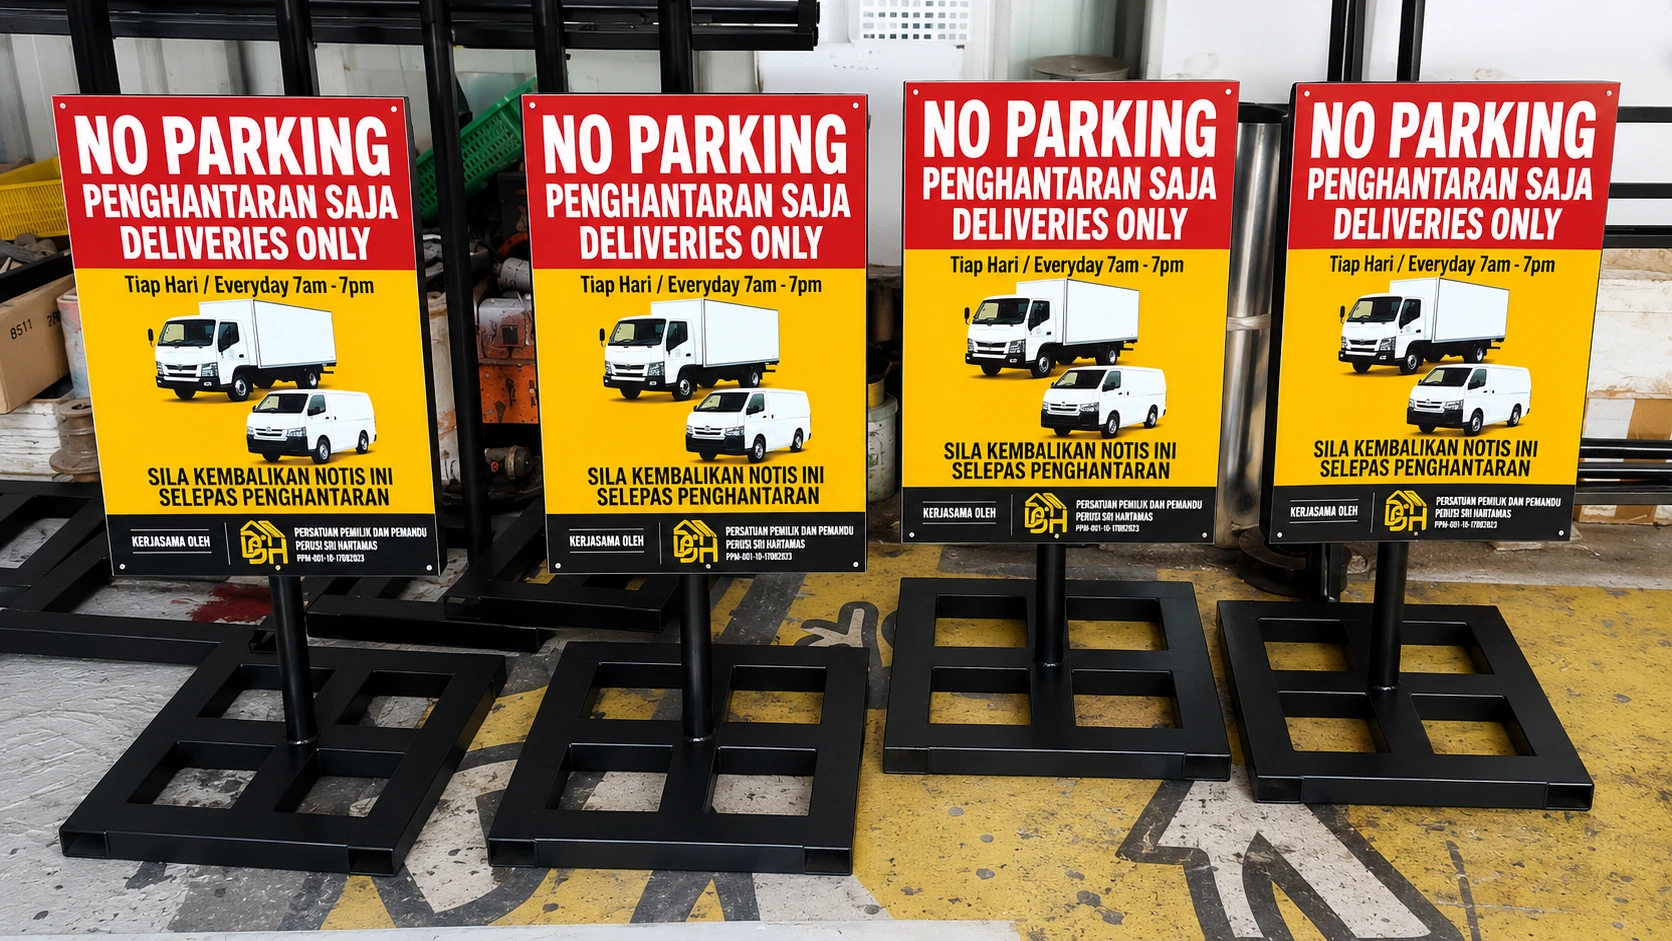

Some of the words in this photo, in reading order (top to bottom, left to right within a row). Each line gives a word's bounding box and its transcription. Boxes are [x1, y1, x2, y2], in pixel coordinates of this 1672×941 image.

[924, 100, 990, 158] NO
[1007, 99, 1216, 158] PARKING
[1311, 101, 1375, 159] NO
[1389, 101, 1596, 159] PARKING
[74, 115, 147, 175] NO
[162, 116, 390, 176] PARKING
[543, 114, 612, 174] NO
[629, 114, 846, 174] PARKING
[923, 166, 1141, 200] PENGHANTARAN
[1149, 166, 1216, 200] SAJA
[1308, 167, 1518, 200] PENGHANTARAN
[1525, 167, 1592, 200] SAJA
[83, 184, 317, 218] PENGHANTARAN
[325, 185, 398, 219] SAJA
[546, 183, 772, 218] PENGHANTARAN
[782, 183, 851, 218] SAJA
[953, 208, 1108, 240] DELIVERIES
[1117, 207, 1188, 240] ONLY
[1334, 208, 1483, 240] DELIVERIES
[1491, 208, 1562, 240] ONLY
[120, 226, 288, 260] DELIVERIES
[296, 226, 370, 260] ONLY
[580, 225, 742, 259] DELIVERIES
[751, 225, 823, 259] ONLY
[951, 256, 982, 276] Tiap
[988, 256, 1018, 273] Hari
[1023, 256, 1030, 273] /
[1035, 256, 1103, 278] Everyday
[1108, 256, 1138, 272] 7am
[1152, 256, 1183, 276] 7pm
[1330, 256, 1359, 275] Tiap
[1365, 255, 1393, 271] Hari
[1397, 255, 1405, 272] /
[1409, 255, 1475, 277] Everyday
[1481, 256, 1510, 272] 7am
[1524, 256, 1555, 276] 7pm
[125, 276, 160, 295] Tiap
[165, 276, 198, 293] Hari
[204, 276, 209, 294] /
[215, 276, 288, 297] Everyday
[293, 276, 326, 293] 7am
[339, 277, 374, 297] 7pm
[581, 276, 614, 295] Tiap
[620, 276, 651, 292] Hari
[657, 275, 663, 293] /
[669, 276, 739, 296] Everyday
[745, 276, 776, 292] 7am
[789, 276, 821, 296] 7pm
[10, 319, 33, 340] 8511
[945, 442, 981, 459] SILA
[988, 442, 1095, 459] KEMBALIKAN
[1102, 442, 1149, 459] NOTIS
[1155, 442, 1176, 459] INI
[1314, 440, 1348, 457] SILA
[1355, 440, 1458, 458] KEMBALIKAN
[1463, 440, 1510, 459] NOTIS
[1516, 440, 1537, 457] INI
[148, 468, 189, 485] SILA
[194, 468, 309, 485] KEMBALIKAN
[315, 468, 365, 485] NOTIS
[371, 468, 392, 485] INI
[588, 468, 627, 485] SILA
[633, 467, 743, 484] KEMBALIKAN
[750, 466, 797, 484] NOTIS
[803, 466, 823, 483] INI
[953, 462, 1025, 479] SELEPAS
[1032, 462, 1169, 479] PENGHANTARAN
[1320, 459, 1389, 477] SELEPAS
[1395, 459, 1530, 476] PENGHANTARAN
[160, 488, 237, 506] SELEPAS
[243, 488, 389, 506] PENGHANTARAN
[598, 488, 672, 506] SELEPAS
[679, 487, 818, 505] PENGHANTARAN
[1077, 500, 1117, 509] PERSATUAN
[1119, 500, 1148, 509] PEMILIK
[1150, 500, 1165, 509] DAN
[1167, 500, 1202, 509] PEMANDU
[923, 508, 972, 518] KERJASAMA
[975, 508, 996, 518] OLEH
[1291, 506, 1336, 517] KERJASAMA
[1339, 506, 1358, 516] OLEH
[132, 536, 185, 547] KERJASAMA
[188, 536, 210, 547] OLEH
[294, 528, 338, 537] PERSATUAN
[340, 527, 371, 537] PEMILIK
[373, 528, 389, 537] DAN
[391, 528, 426, 537] PEMANDU
[570, 536, 620, 546] KERJASAMA
[623, 535, 643, 546] OLEH
[726, 526, 768, 536] PERSATUAN
[770, 526, 799, 535] PEMILIK
[802, 526, 817, 535] DAN
[819, 526, 853, 535] PEMANDU
[324, 541, 336, 550] SRI
